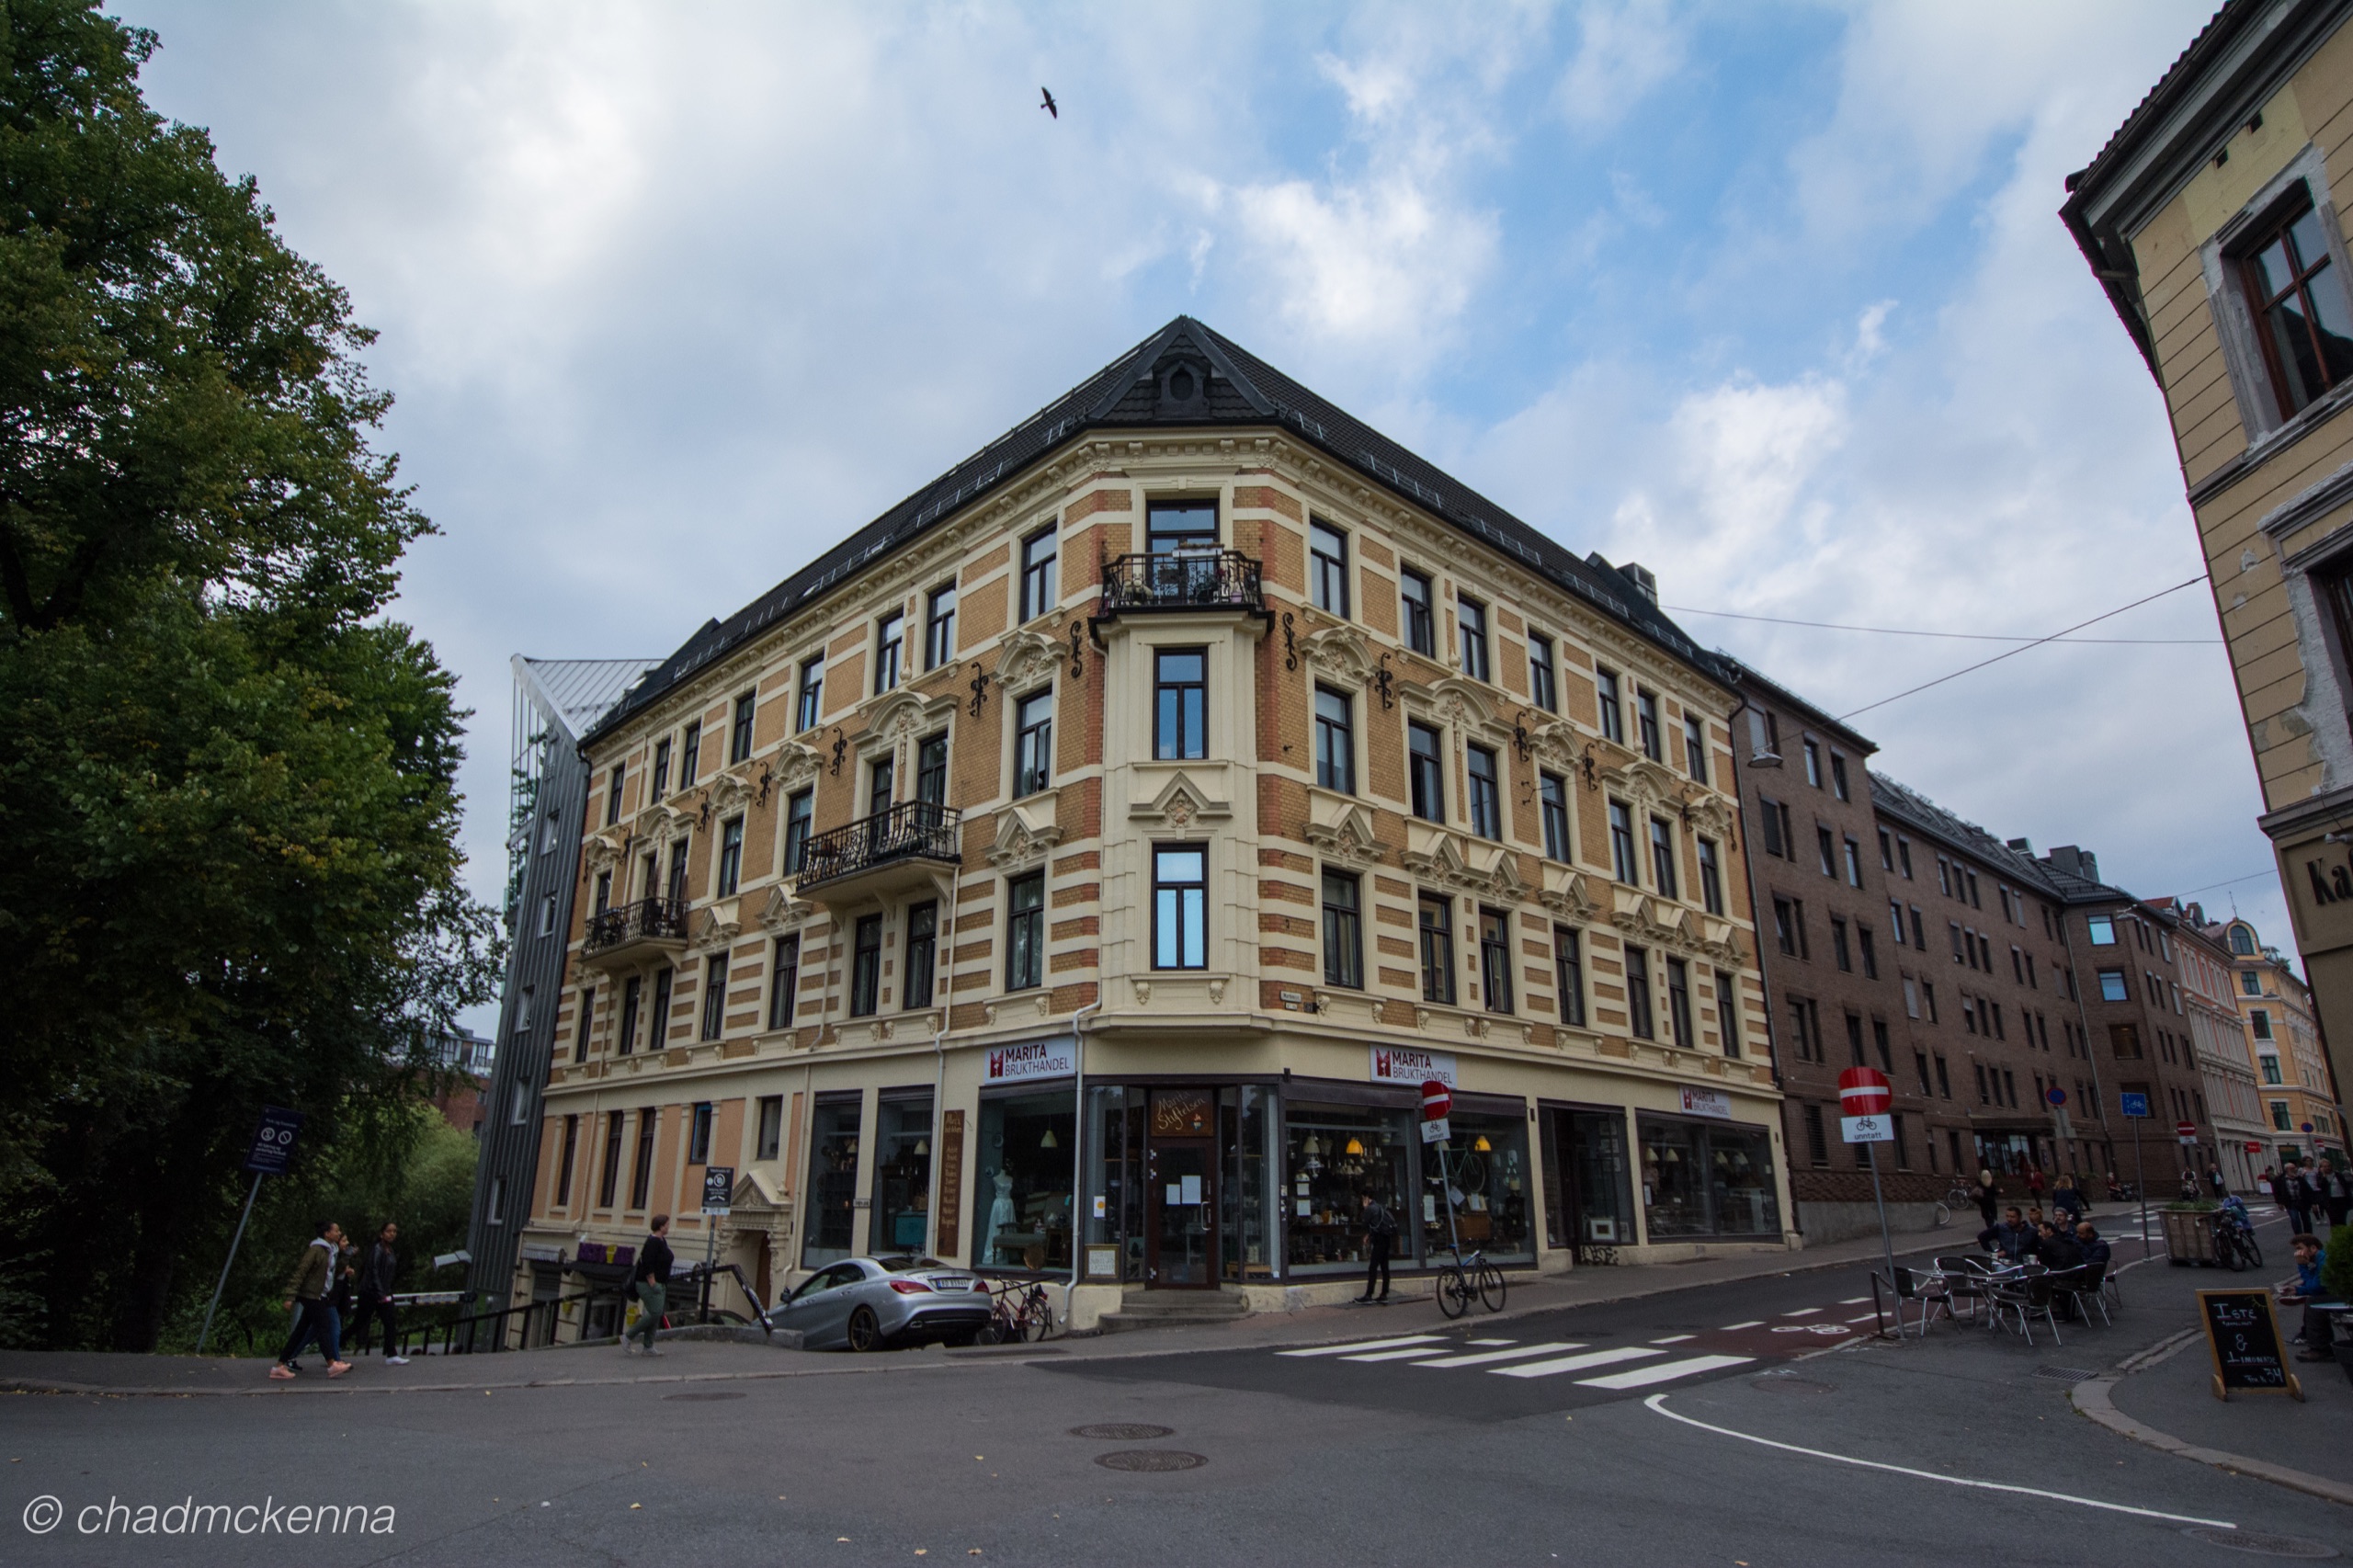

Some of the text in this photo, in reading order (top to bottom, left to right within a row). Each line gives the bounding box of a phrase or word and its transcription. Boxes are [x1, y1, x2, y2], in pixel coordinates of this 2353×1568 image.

[2305, 847, 2353, 904] Ka
[1006, 1043, 1047, 1063] MARITA
[1392, 1051, 1432, 1069] MARITA
[1006, 1057, 1070, 1076] BRUKTHANDEL
[1392, 1067, 1452, 1084] BRUKTHANDEL
[1156, 1090, 1191, 1117] Marita
[1692, 1090, 1716, 1103] MARITA
[1157, 1096, 1206, 1131] Stiftelsen
[1693, 1102, 1729, 1115] BRUKTHANDEL
[1854, 1131, 1882, 1140] unntatt
[2213, 1302, 2257, 1319] ISTE
